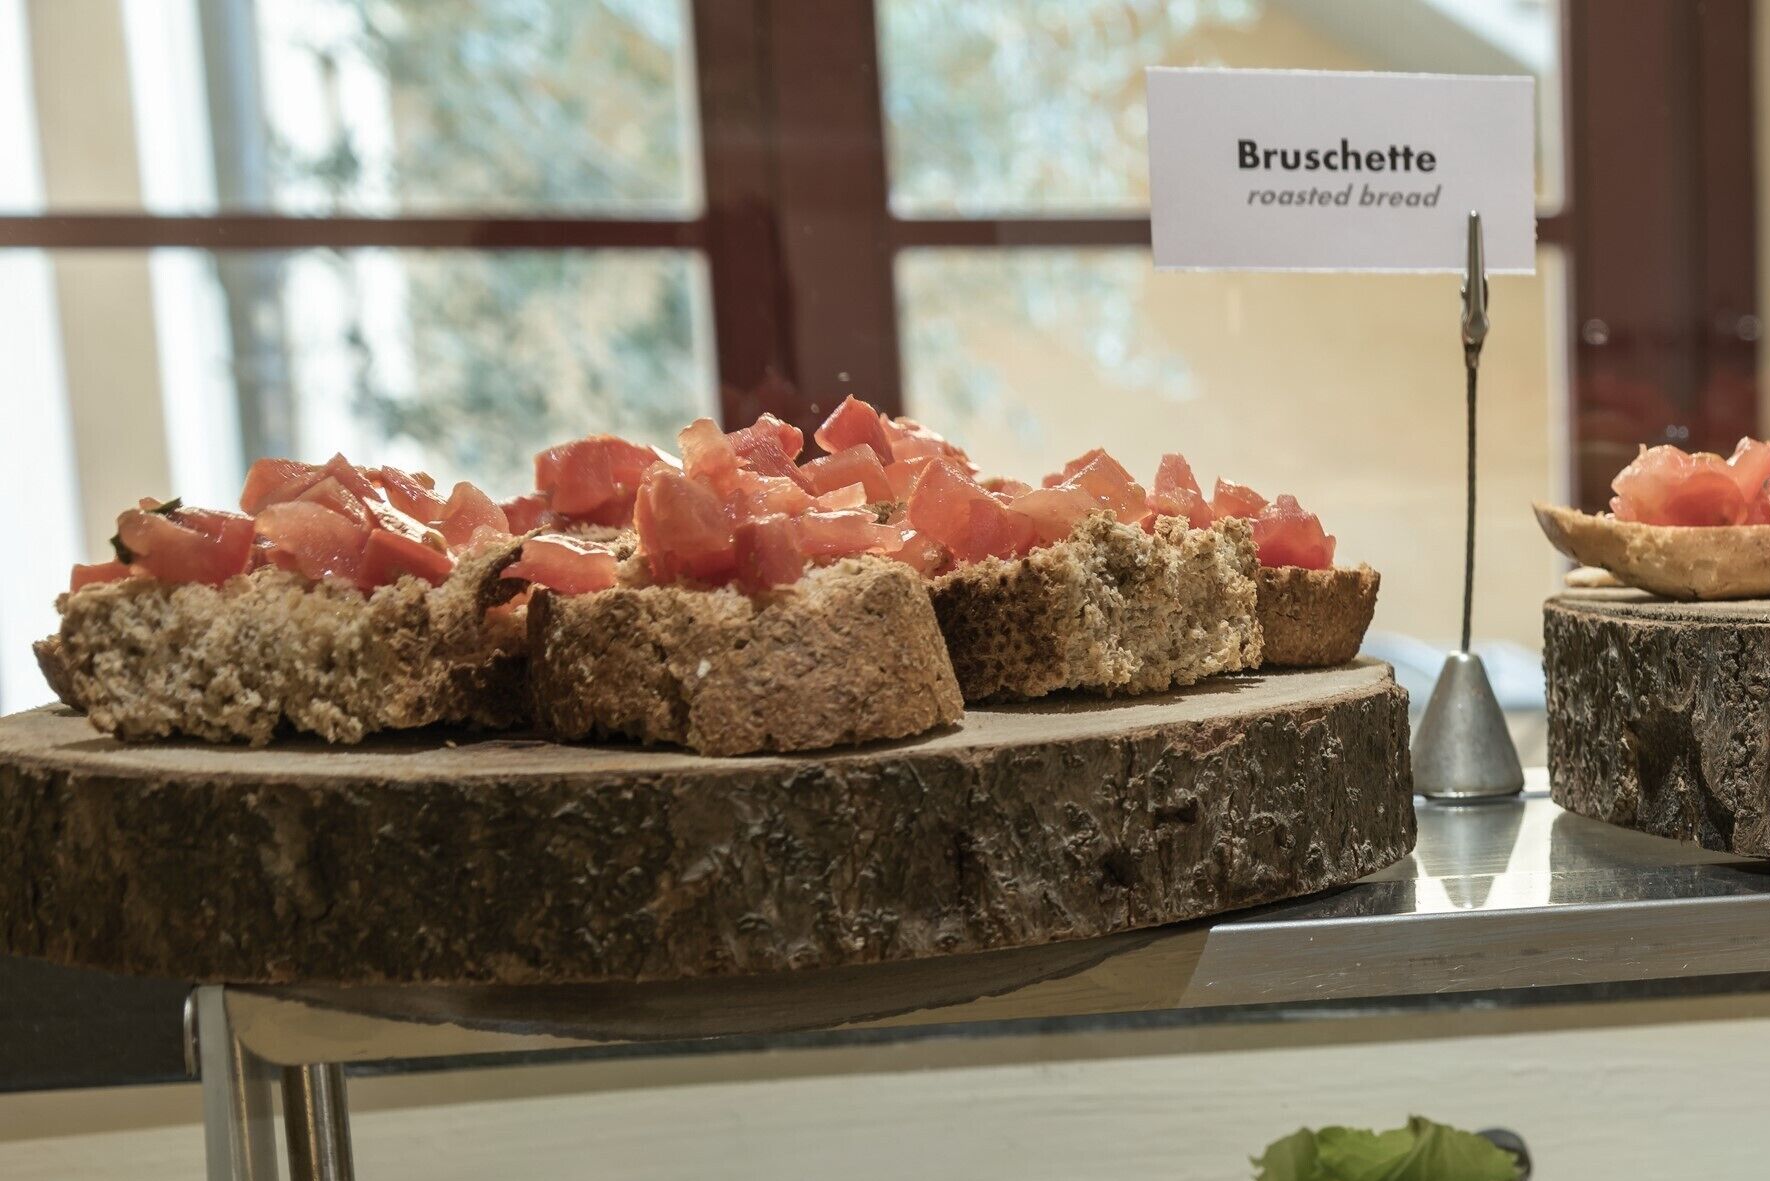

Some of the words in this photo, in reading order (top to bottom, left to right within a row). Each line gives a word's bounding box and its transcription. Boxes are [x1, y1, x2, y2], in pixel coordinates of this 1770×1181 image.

[1238, 138, 1436, 172] Bruschette
[1246, 183, 1354, 207] roasted
[1358, 184, 1442, 208] bread
